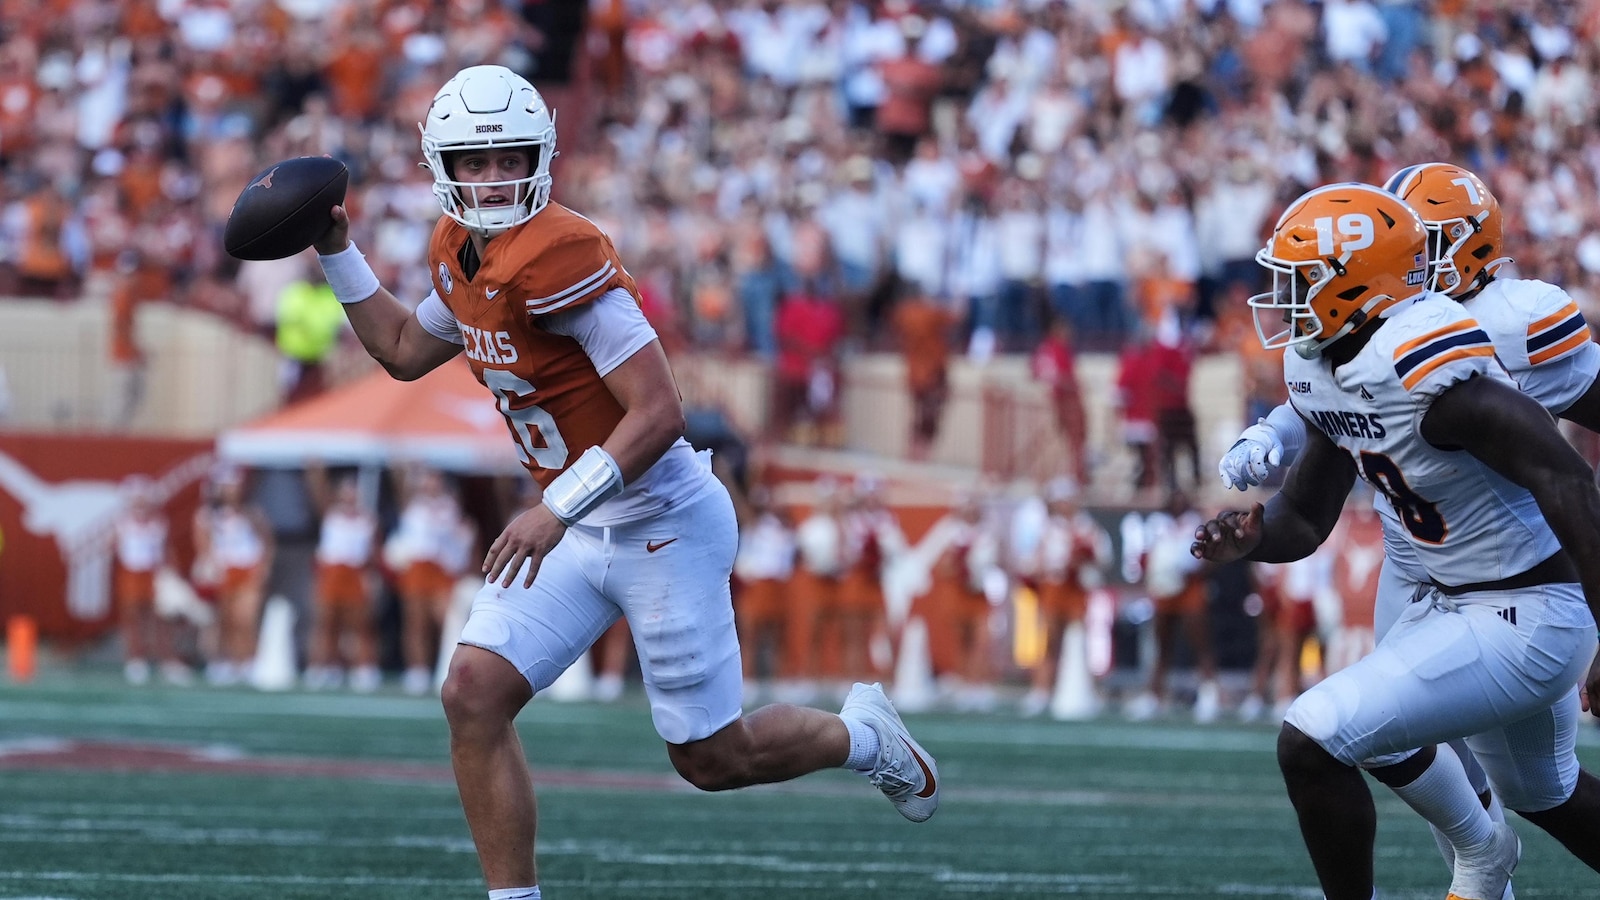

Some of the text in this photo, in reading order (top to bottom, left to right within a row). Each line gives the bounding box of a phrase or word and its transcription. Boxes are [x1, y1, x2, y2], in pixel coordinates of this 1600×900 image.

[475, 124, 503, 133] HORNS
[1450, 177, 1480, 205] 7
[1313, 212, 1375, 256] 19
[482, 367, 569, 470] 6
[1310, 410, 1387, 439] MINERS
